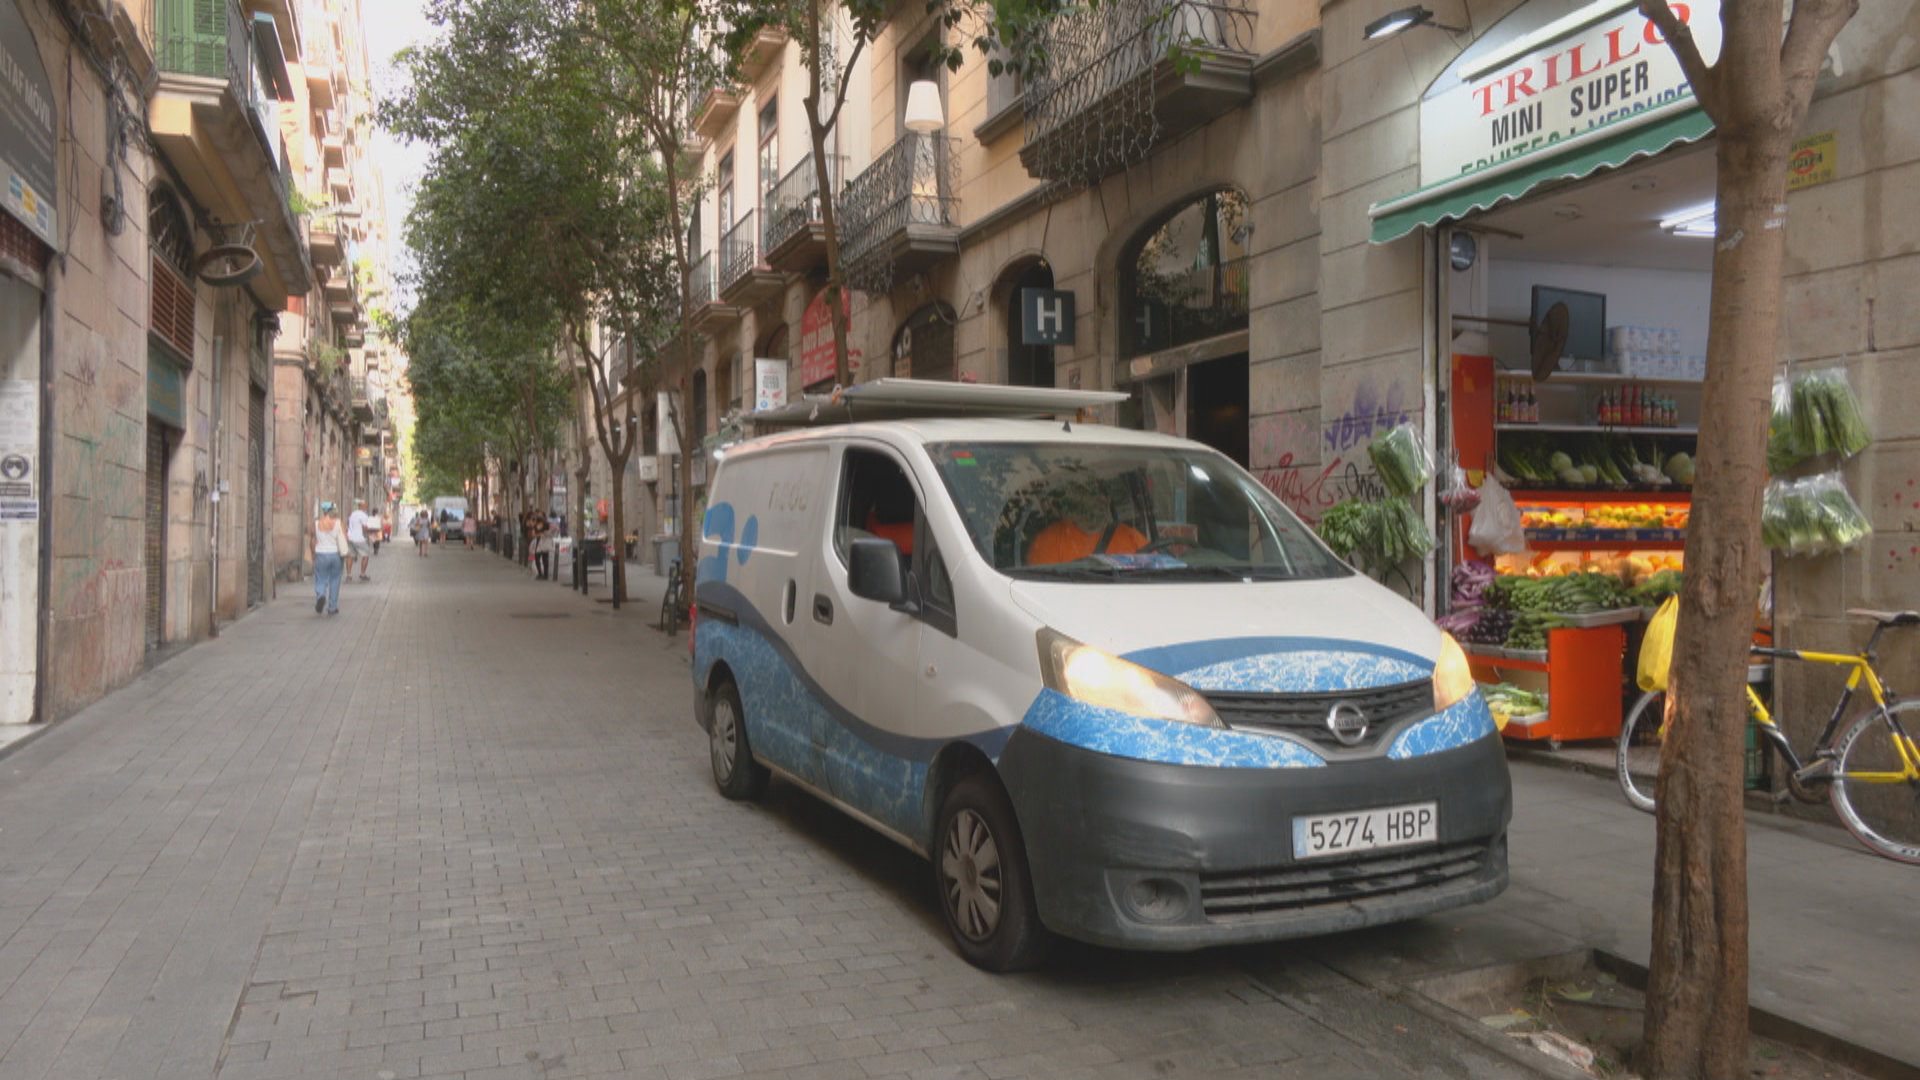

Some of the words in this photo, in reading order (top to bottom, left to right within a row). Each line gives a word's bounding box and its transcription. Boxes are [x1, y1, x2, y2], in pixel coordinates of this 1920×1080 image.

[1491, 101, 1543, 147] MINI
[1570, 60, 1649, 118] SUPER
[1037, 297, 1062, 333] H
[1311, 815, 1374, 850] 5274
[1387, 809, 1431, 841] HBP
